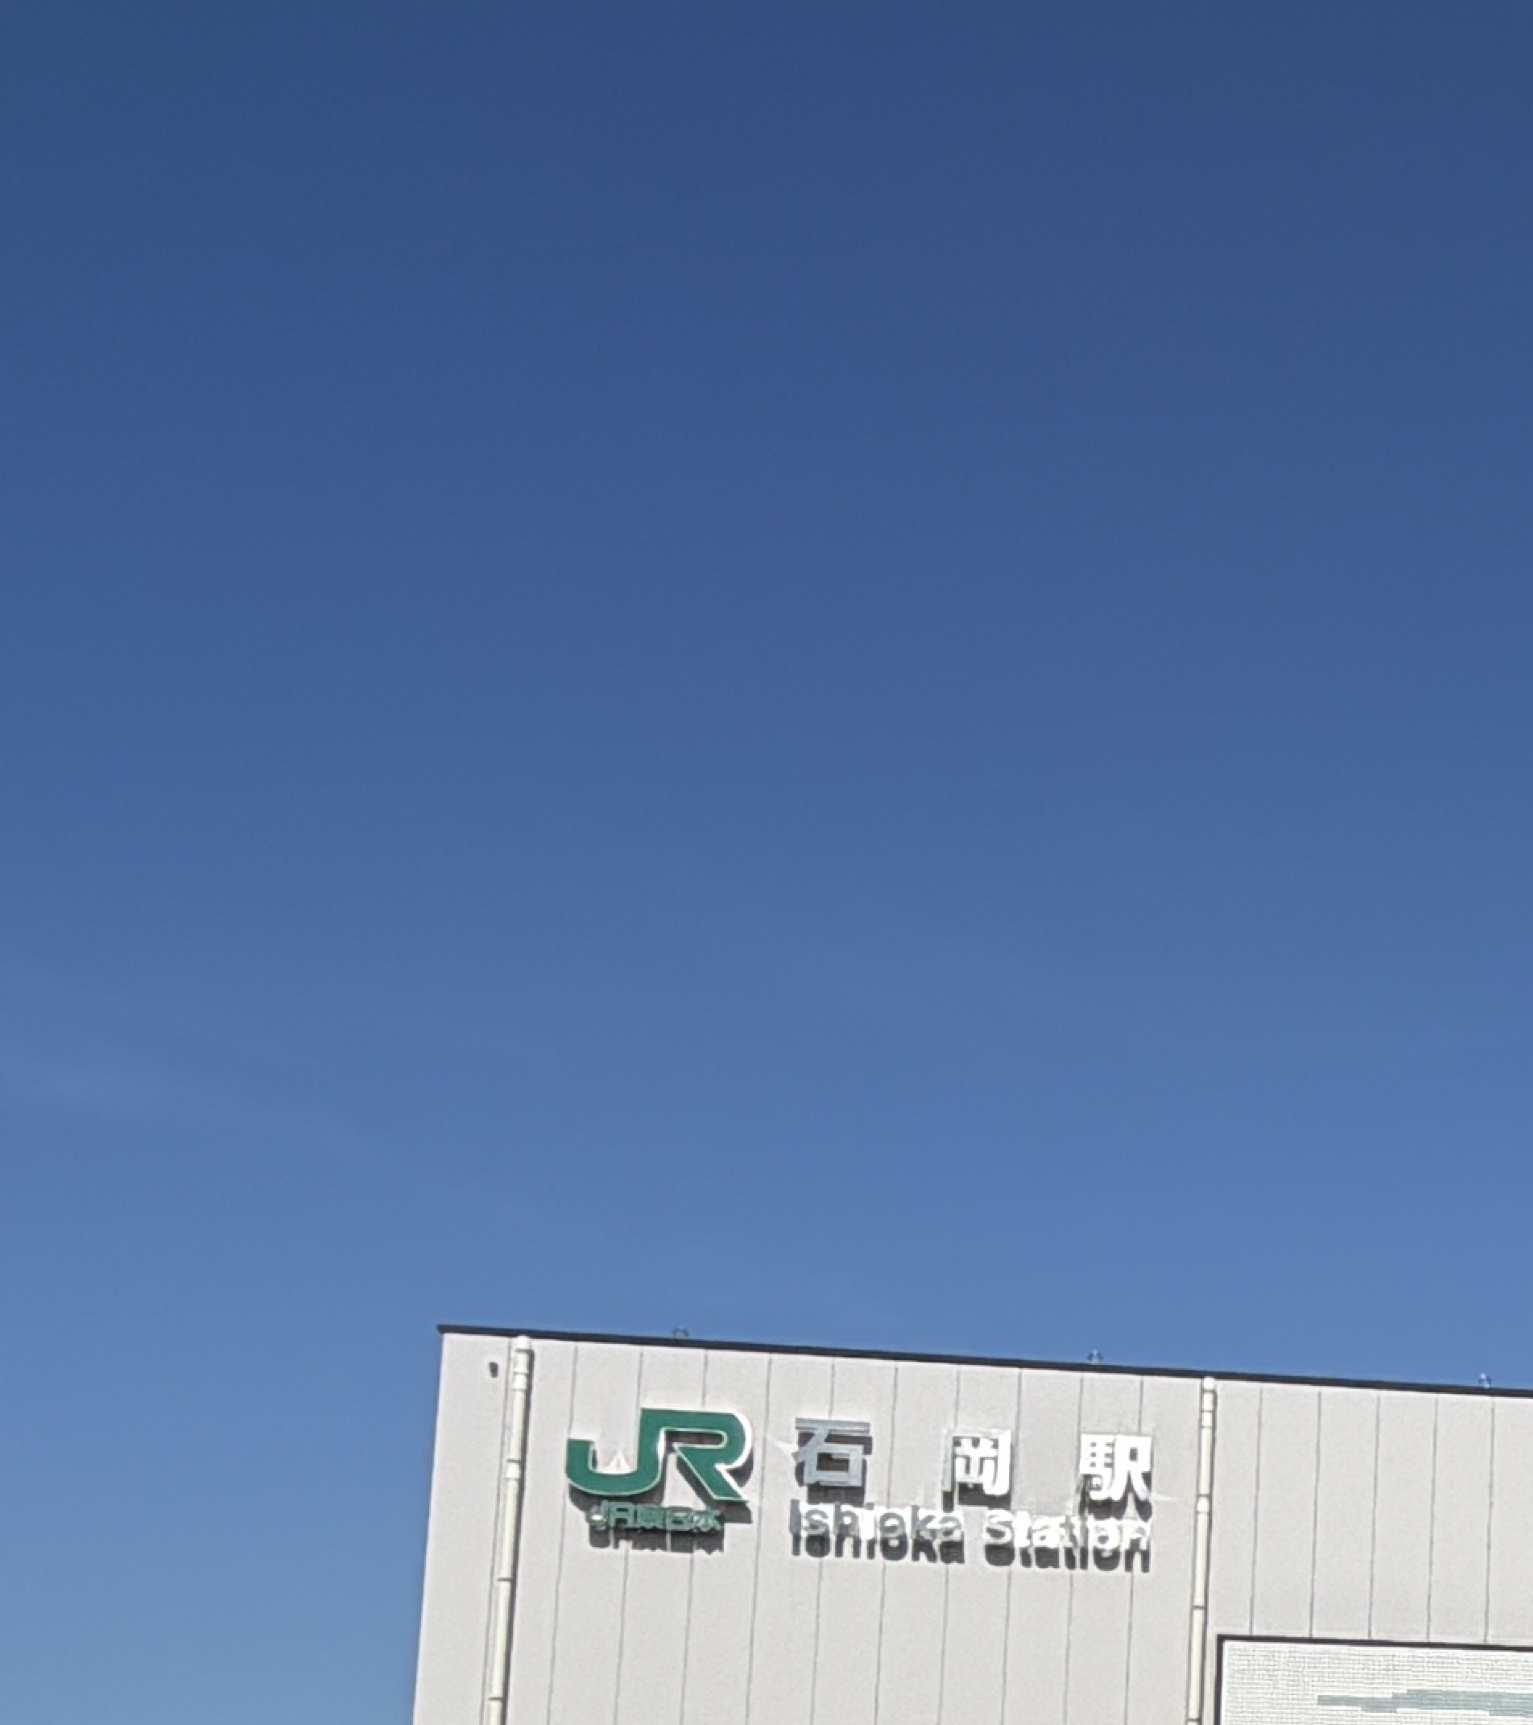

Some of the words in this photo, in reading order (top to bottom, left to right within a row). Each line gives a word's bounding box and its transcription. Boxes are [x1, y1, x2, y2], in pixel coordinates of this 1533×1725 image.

[565, 1407, 752, 1502] JR
[794, 1417, 1153, 1503] 石岡駅
[789, 1498, 964, 1541] Ishioka
[984, 1508, 1152, 1551] Station
